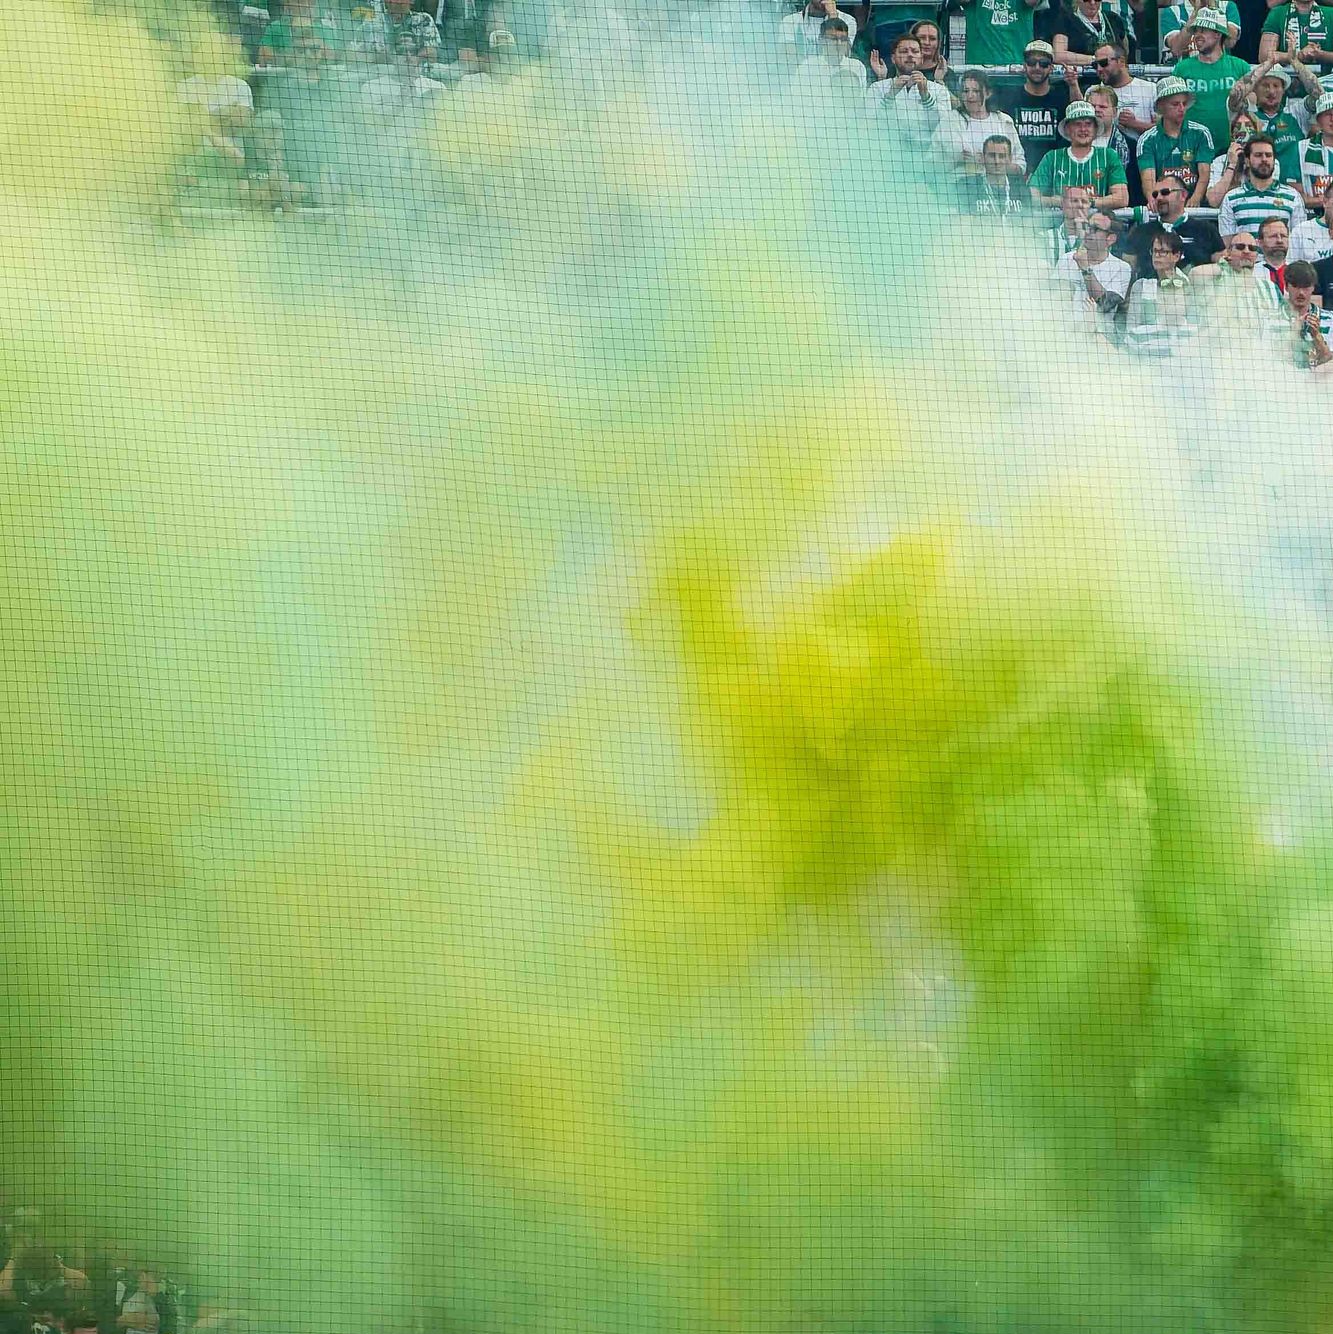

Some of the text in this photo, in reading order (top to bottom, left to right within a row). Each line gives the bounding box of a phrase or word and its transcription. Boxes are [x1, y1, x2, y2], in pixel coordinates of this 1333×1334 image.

[1187, 77, 1235, 92] RAPID
[1021, 110, 1052, 123] VIOLA
[1019, 124, 1056, 137] MERDA
